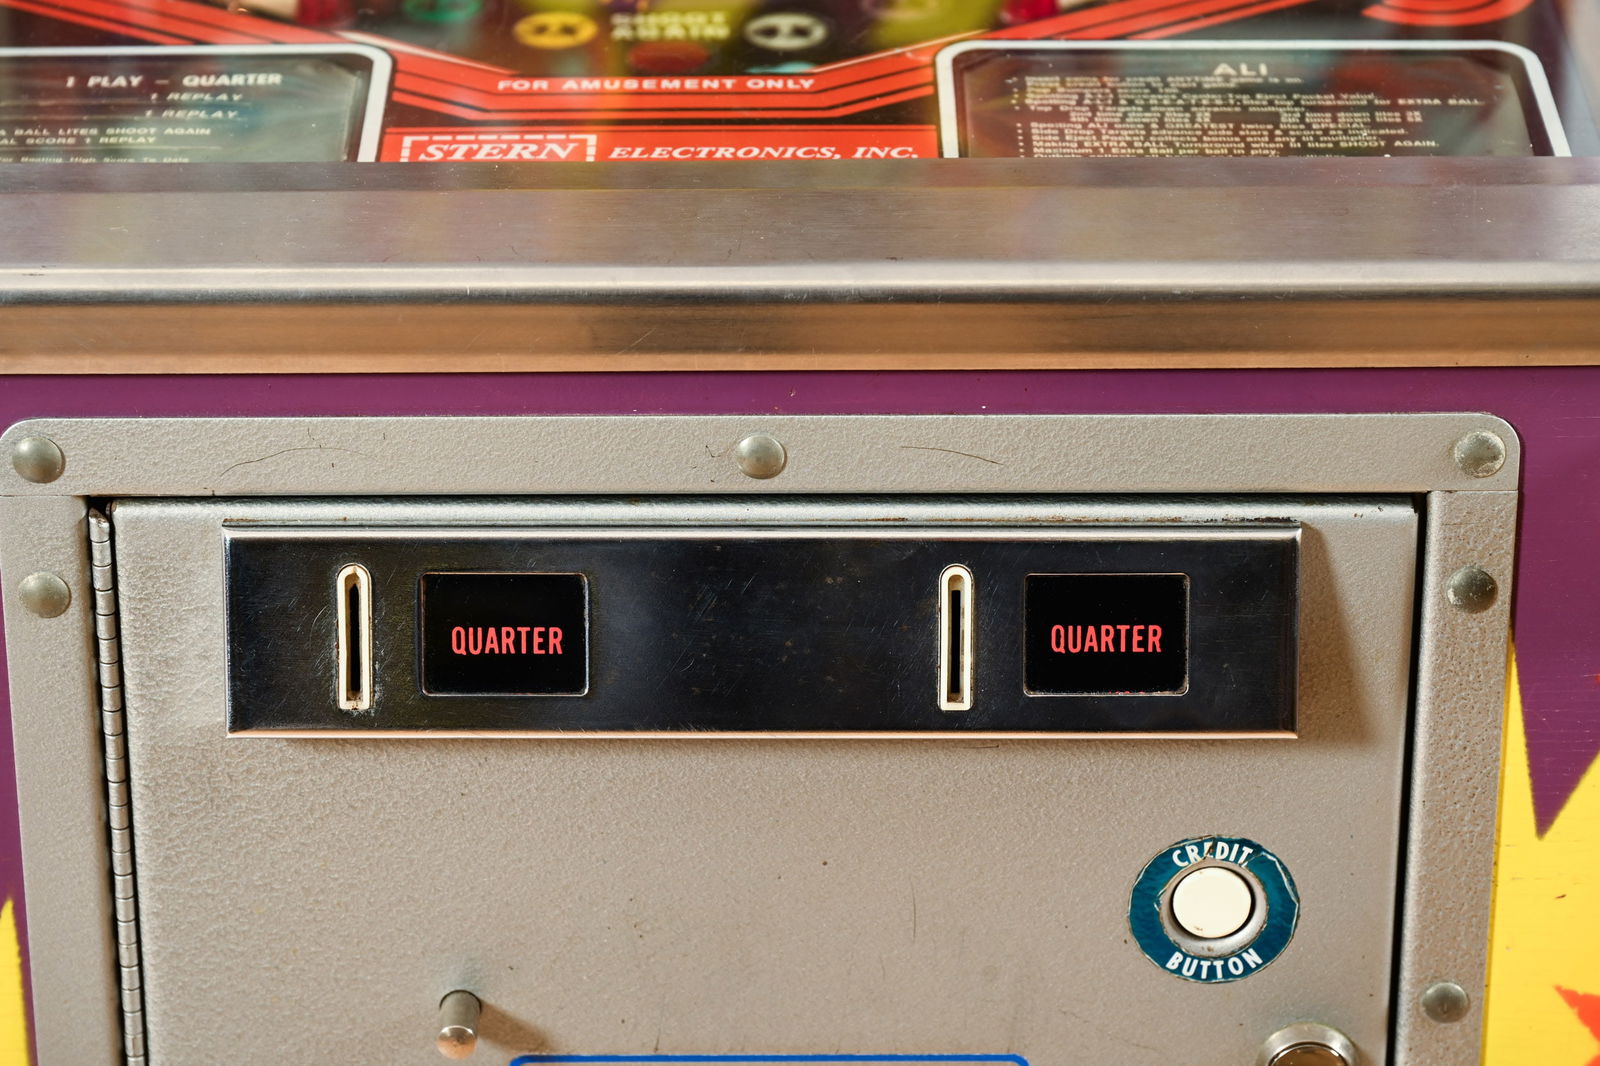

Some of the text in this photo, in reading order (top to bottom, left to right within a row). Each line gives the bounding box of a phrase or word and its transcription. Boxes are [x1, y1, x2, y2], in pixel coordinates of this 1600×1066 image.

[1213, 63, 1268, 76] ALI
[66, 76, 77, 88] 1
[87, 75, 144, 88] PLAY
[182, 73, 283, 87] QUARTER
[498, 79, 816, 90] FOR AMUSEMENT ONLY
[166, 92, 243, 101] REPLAY
[162, 110, 238, 119] REPLAY
[14, 128, 51, 136] BALL
[25, 137, 77, 145] SCORE
[418, 143, 579, 161] STERN
[608, 146, 920, 160] ELECTRONICS, INC.
[452, 626, 563, 656] QUARTER
[1051, 625, 1163, 654] QUARTER
[1172, 842, 1254, 868] CREDIT
[1166, 948, 1263, 979] BUTTON
